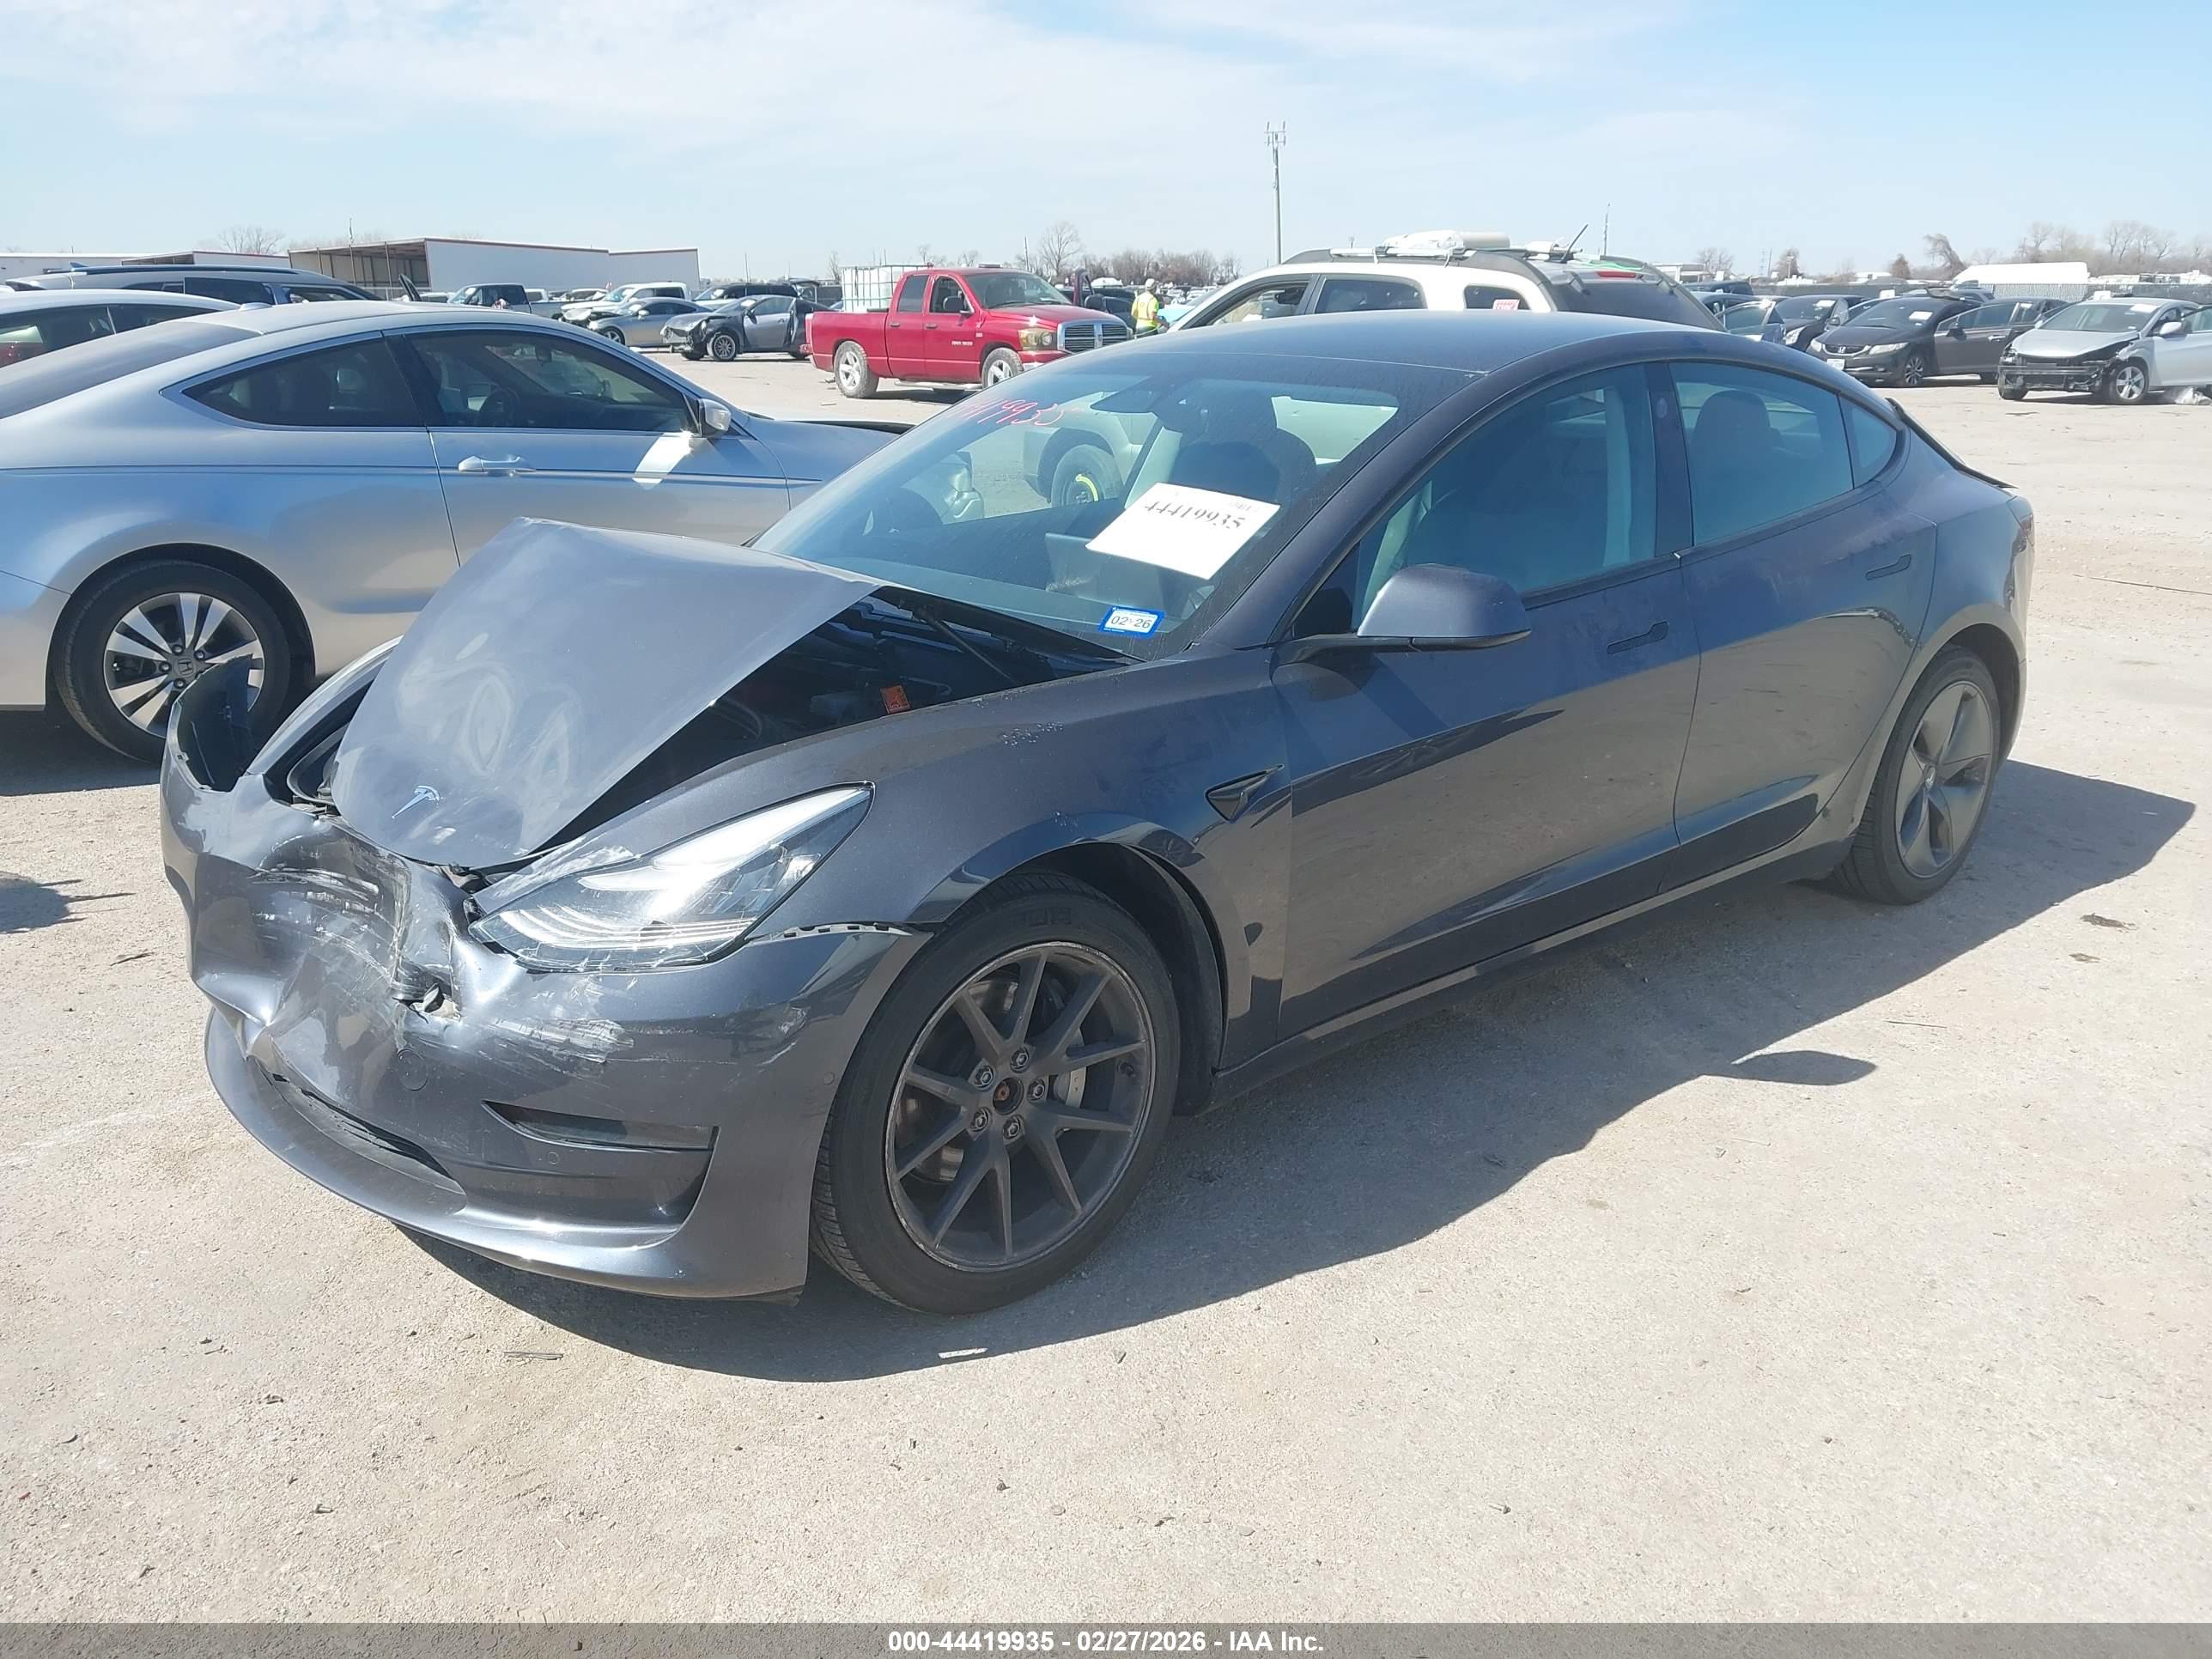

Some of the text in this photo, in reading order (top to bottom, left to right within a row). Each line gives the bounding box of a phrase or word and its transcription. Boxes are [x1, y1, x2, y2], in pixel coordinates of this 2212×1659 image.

[1144, 501, 1246, 529] 44419935
[1111, 616, 1152, 629] 02 26
